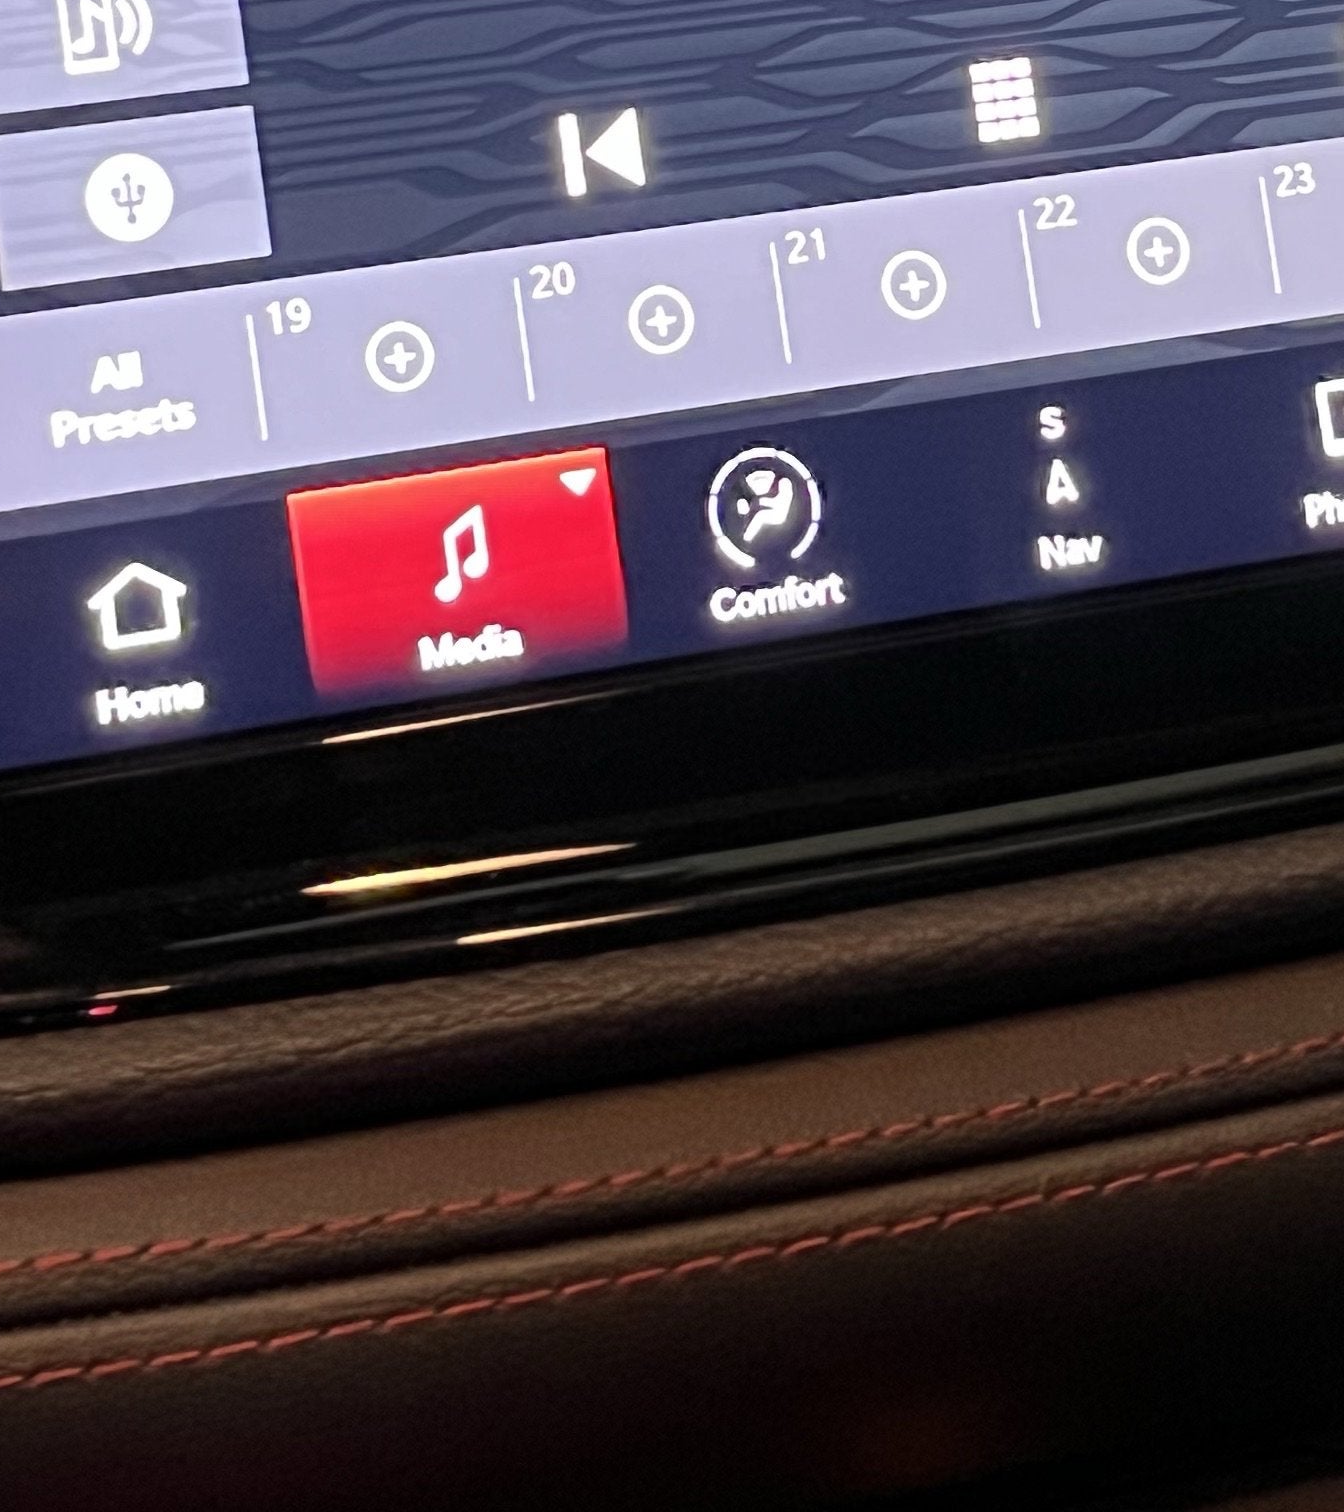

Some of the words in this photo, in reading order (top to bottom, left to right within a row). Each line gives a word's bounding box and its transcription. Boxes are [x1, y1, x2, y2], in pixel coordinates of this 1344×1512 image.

[1274, 161, 1318, 198] 23
[1034, 195, 1078, 231] 22
[784, 228, 828, 265] 21
[526, 260, 576, 299] 20
[264, 296, 313, 336] 19
[89, 350, 143, 394] All
[50, 399, 198, 448] Presets
[1037, 532, 1104, 572] Nav
[708, 572, 846, 623] Comfort
[418, 624, 524, 670] Media
[95, 678, 206, 724] Home
